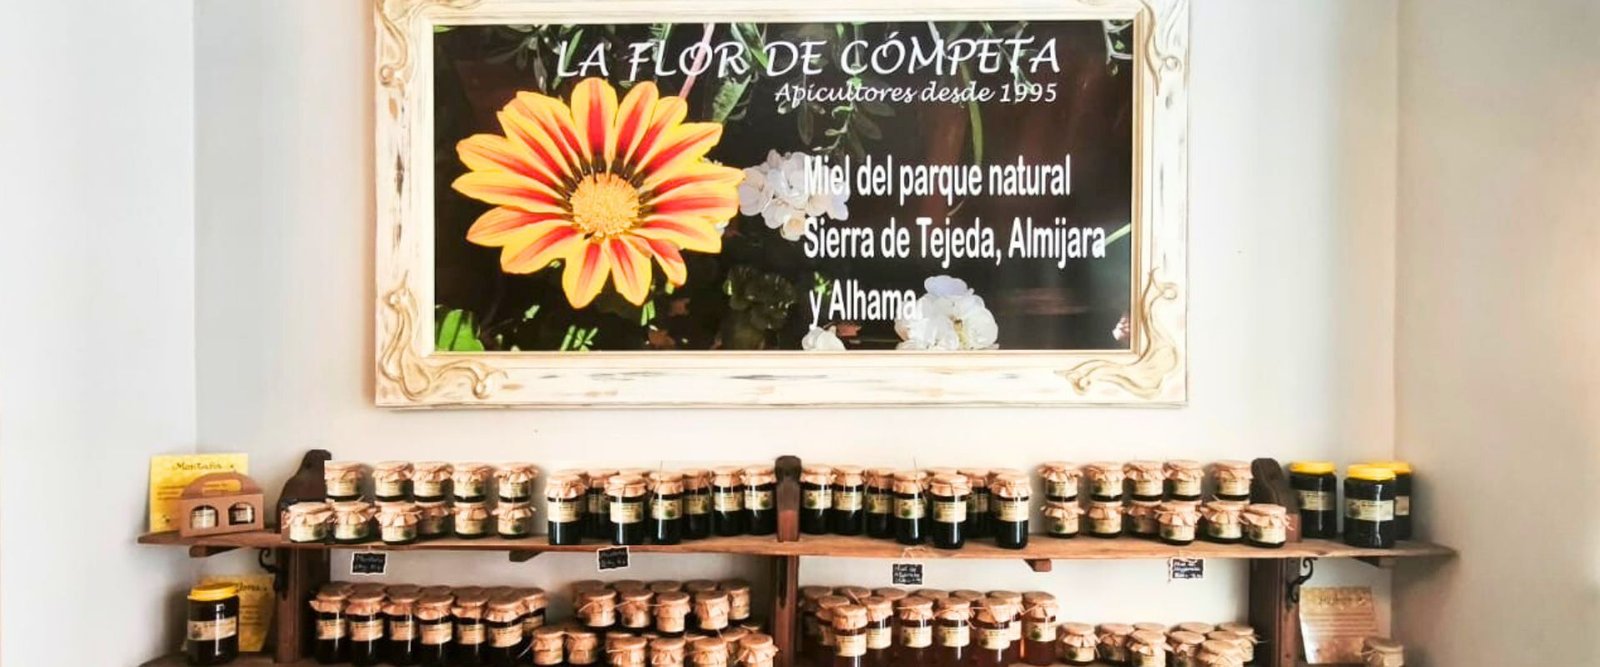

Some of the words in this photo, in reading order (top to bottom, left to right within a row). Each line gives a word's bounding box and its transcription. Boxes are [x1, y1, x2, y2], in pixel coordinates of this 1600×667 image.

[557, 40, 609, 77] LA
[628, 40, 750, 82] FLOR
[764, 40, 827, 76] DE
[841, 32, 1061, 76] CÓMPETA
[775, 82, 916, 108] Apicultores
[921, 81, 995, 102] desde
[1000, 82, 1057, 104] 1995
[804, 154, 850, 196] Miel
[856, 154, 892, 196] del
[900, 164, 982, 206] parque
[989, 153, 1071, 196] natural
[804, 216, 875, 259] Sierra
[881, 217, 911, 259] de
[915, 216, 1002, 269] Tejeda,
[1008, 216, 1106, 269] Almijara
[809, 289, 823, 330] y
